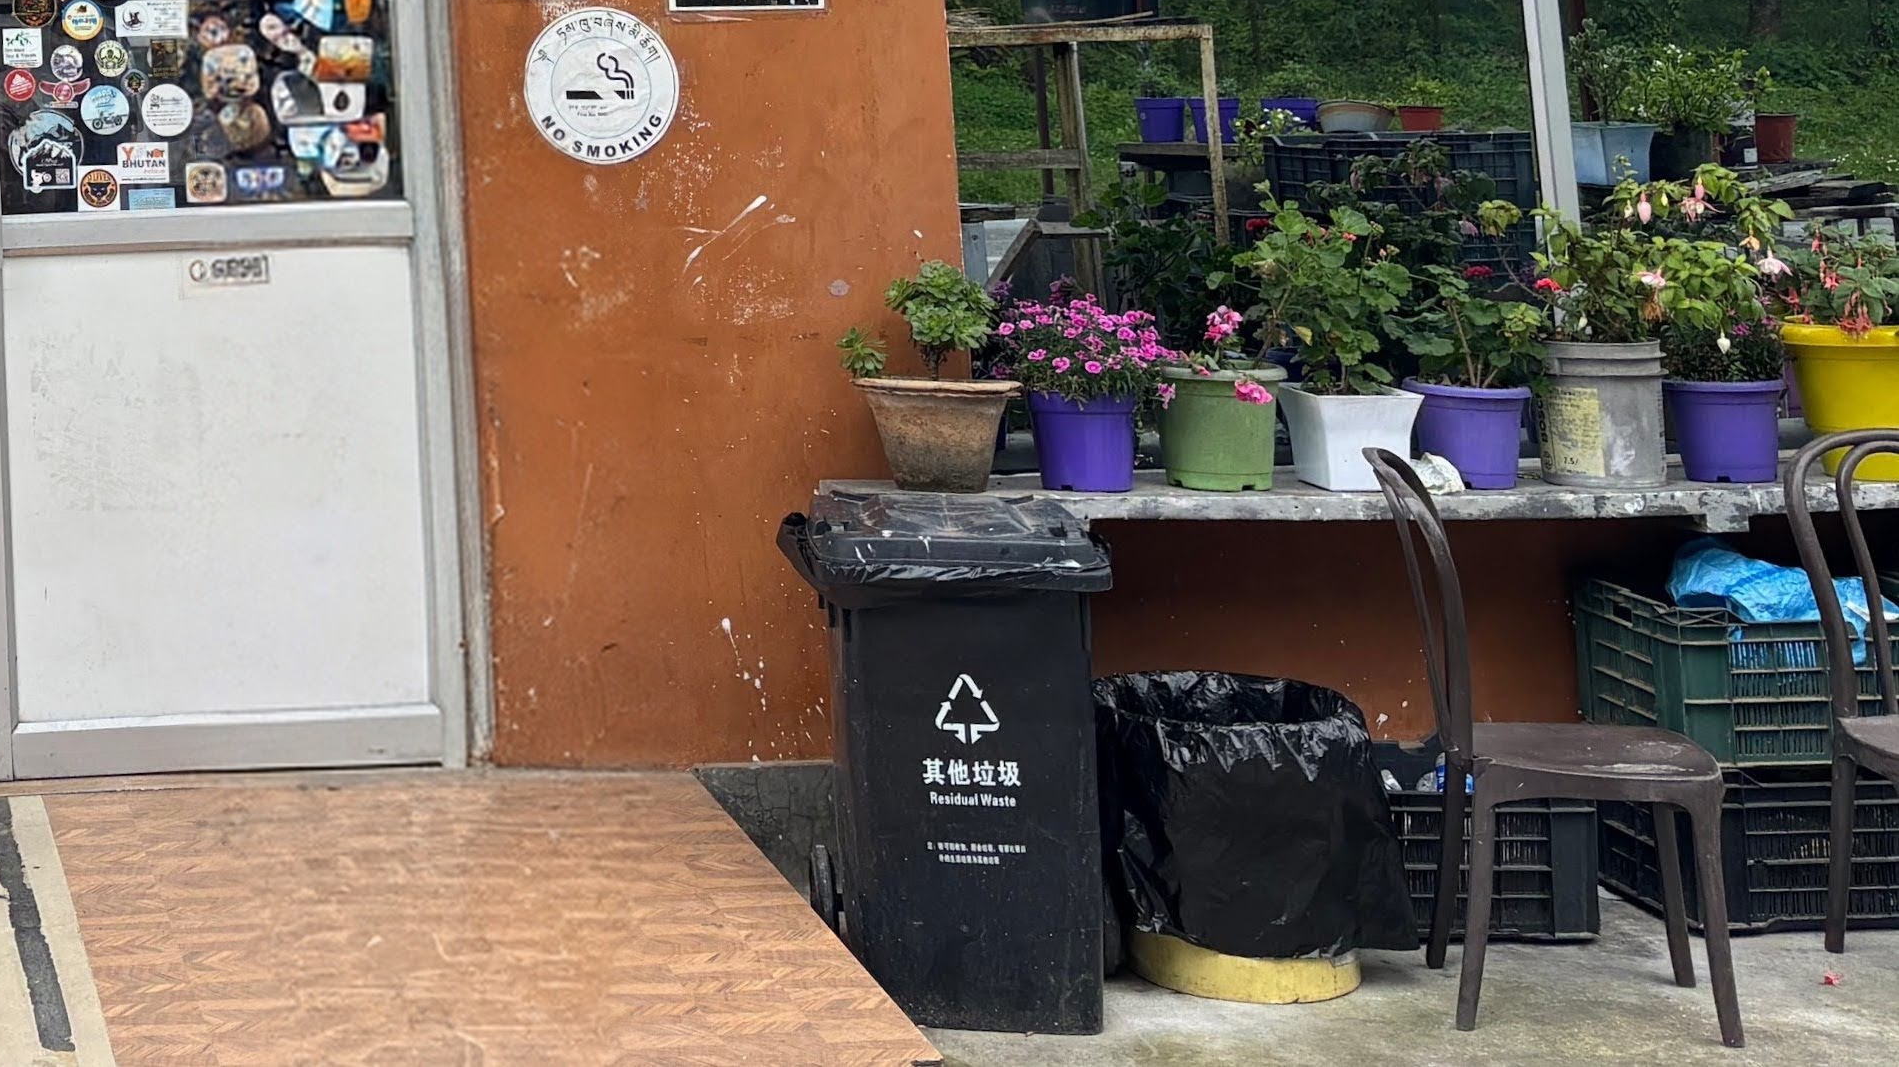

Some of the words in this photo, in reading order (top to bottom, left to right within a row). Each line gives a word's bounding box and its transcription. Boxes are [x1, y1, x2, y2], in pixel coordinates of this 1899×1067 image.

[541, 115, 566, 141] NO
[571, 114, 663, 159] SMOKING
[121, 159, 166, 169] BHUTAN
[922, 757, 1022, 787] 其他垃圾
[929, 791, 978, 806] Residual
[979, 793, 1017, 807] Waste
